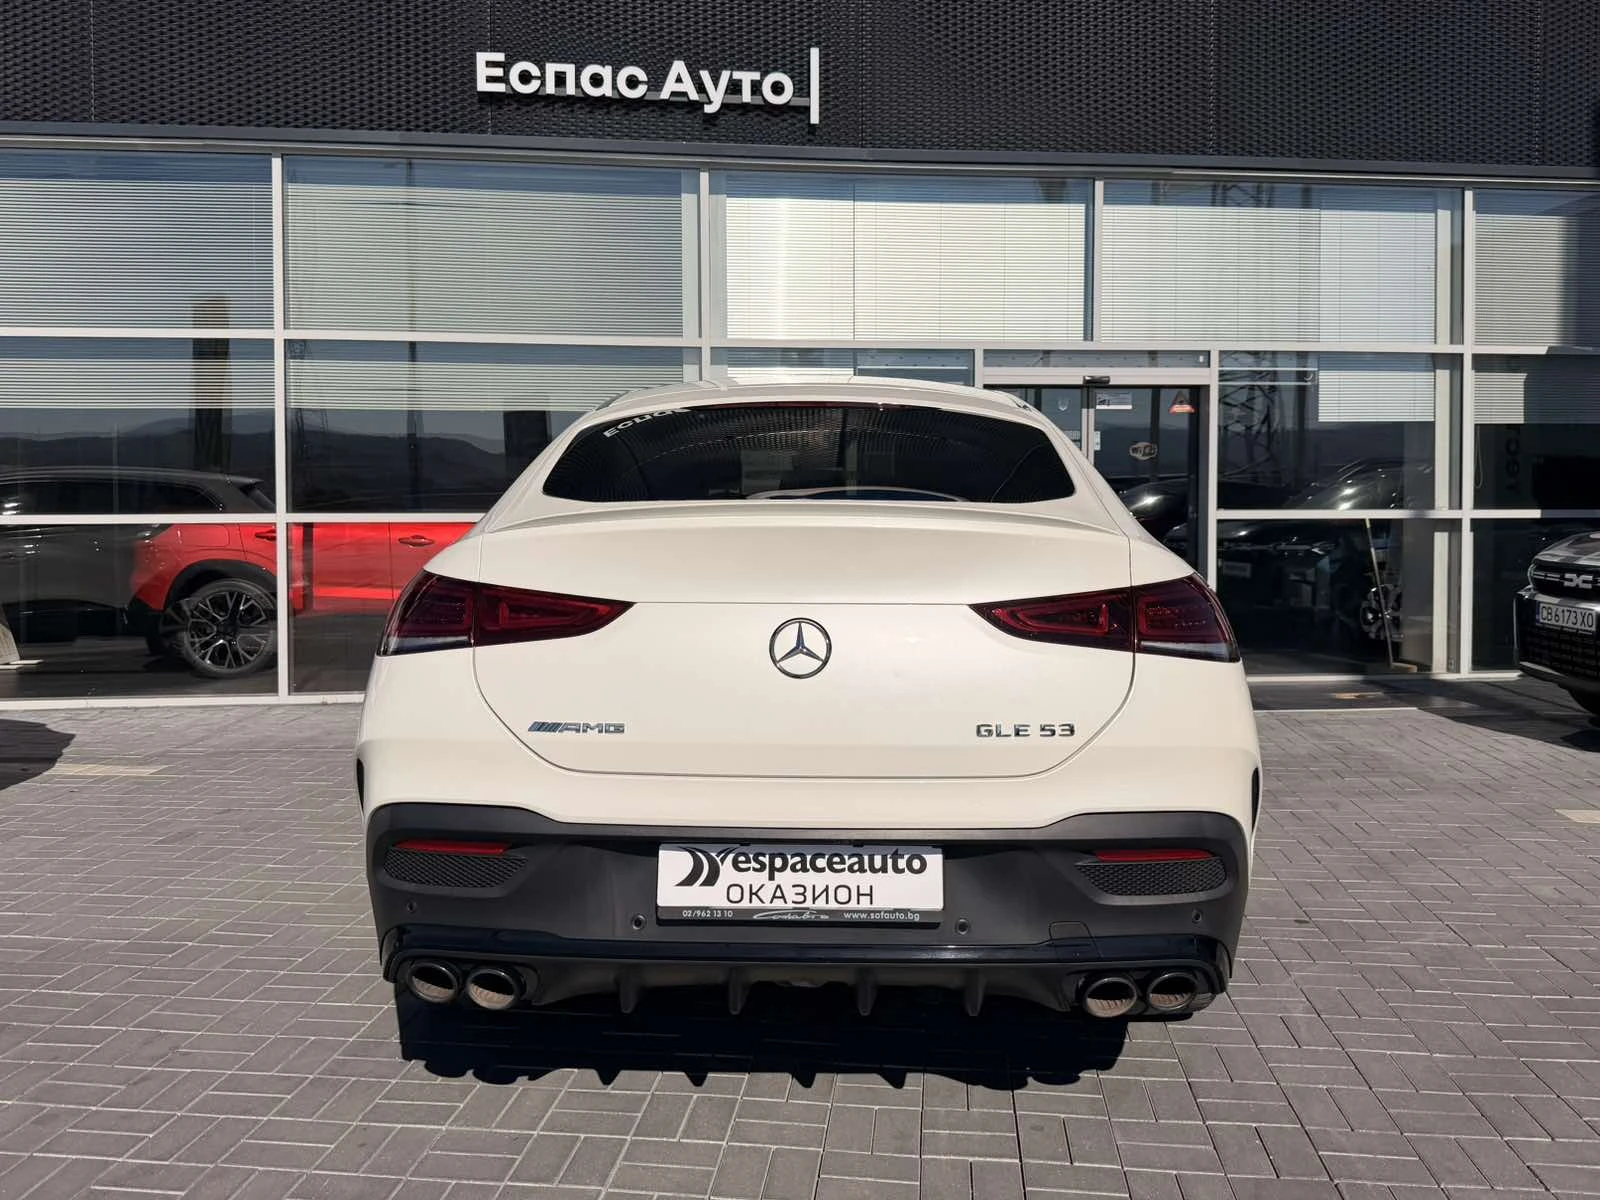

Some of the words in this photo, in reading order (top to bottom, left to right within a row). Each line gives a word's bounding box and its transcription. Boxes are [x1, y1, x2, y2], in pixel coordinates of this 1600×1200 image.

[476, 51, 649, 99] Еспас
[659, 60, 795, 114] Ауто
[976, 723, 1031, 738] GLE
[1039, 723, 1075, 737] 53
[731, 848, 928, 881] espaceauto
[726, 883, 874, 905] ОКАЗИОН
[682, 909, 711, 919] 02/962
[843, 910, 920, 921] www.sofauto.bg
